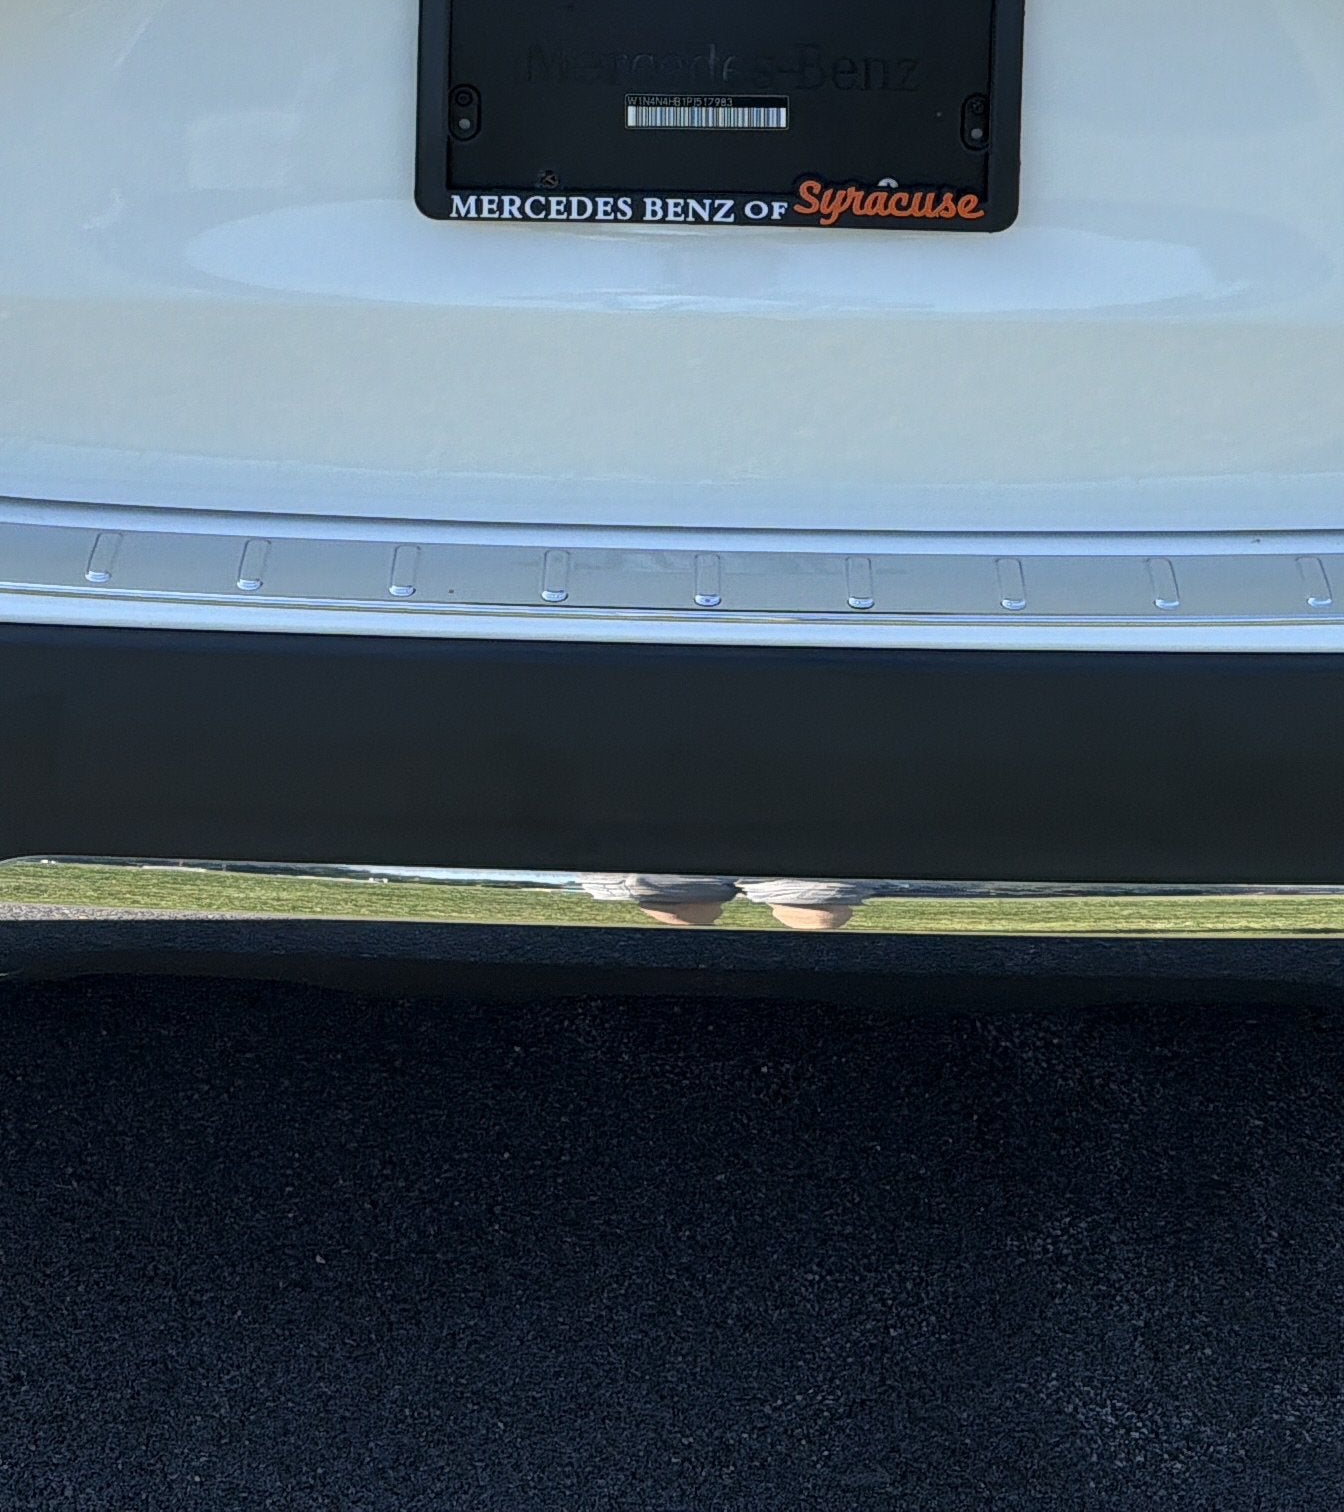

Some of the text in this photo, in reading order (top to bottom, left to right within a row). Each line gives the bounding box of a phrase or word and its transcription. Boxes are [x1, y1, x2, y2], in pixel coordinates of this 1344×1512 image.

[449, 180, 984, 226] MERCEDES BENZ OF Syracuse
